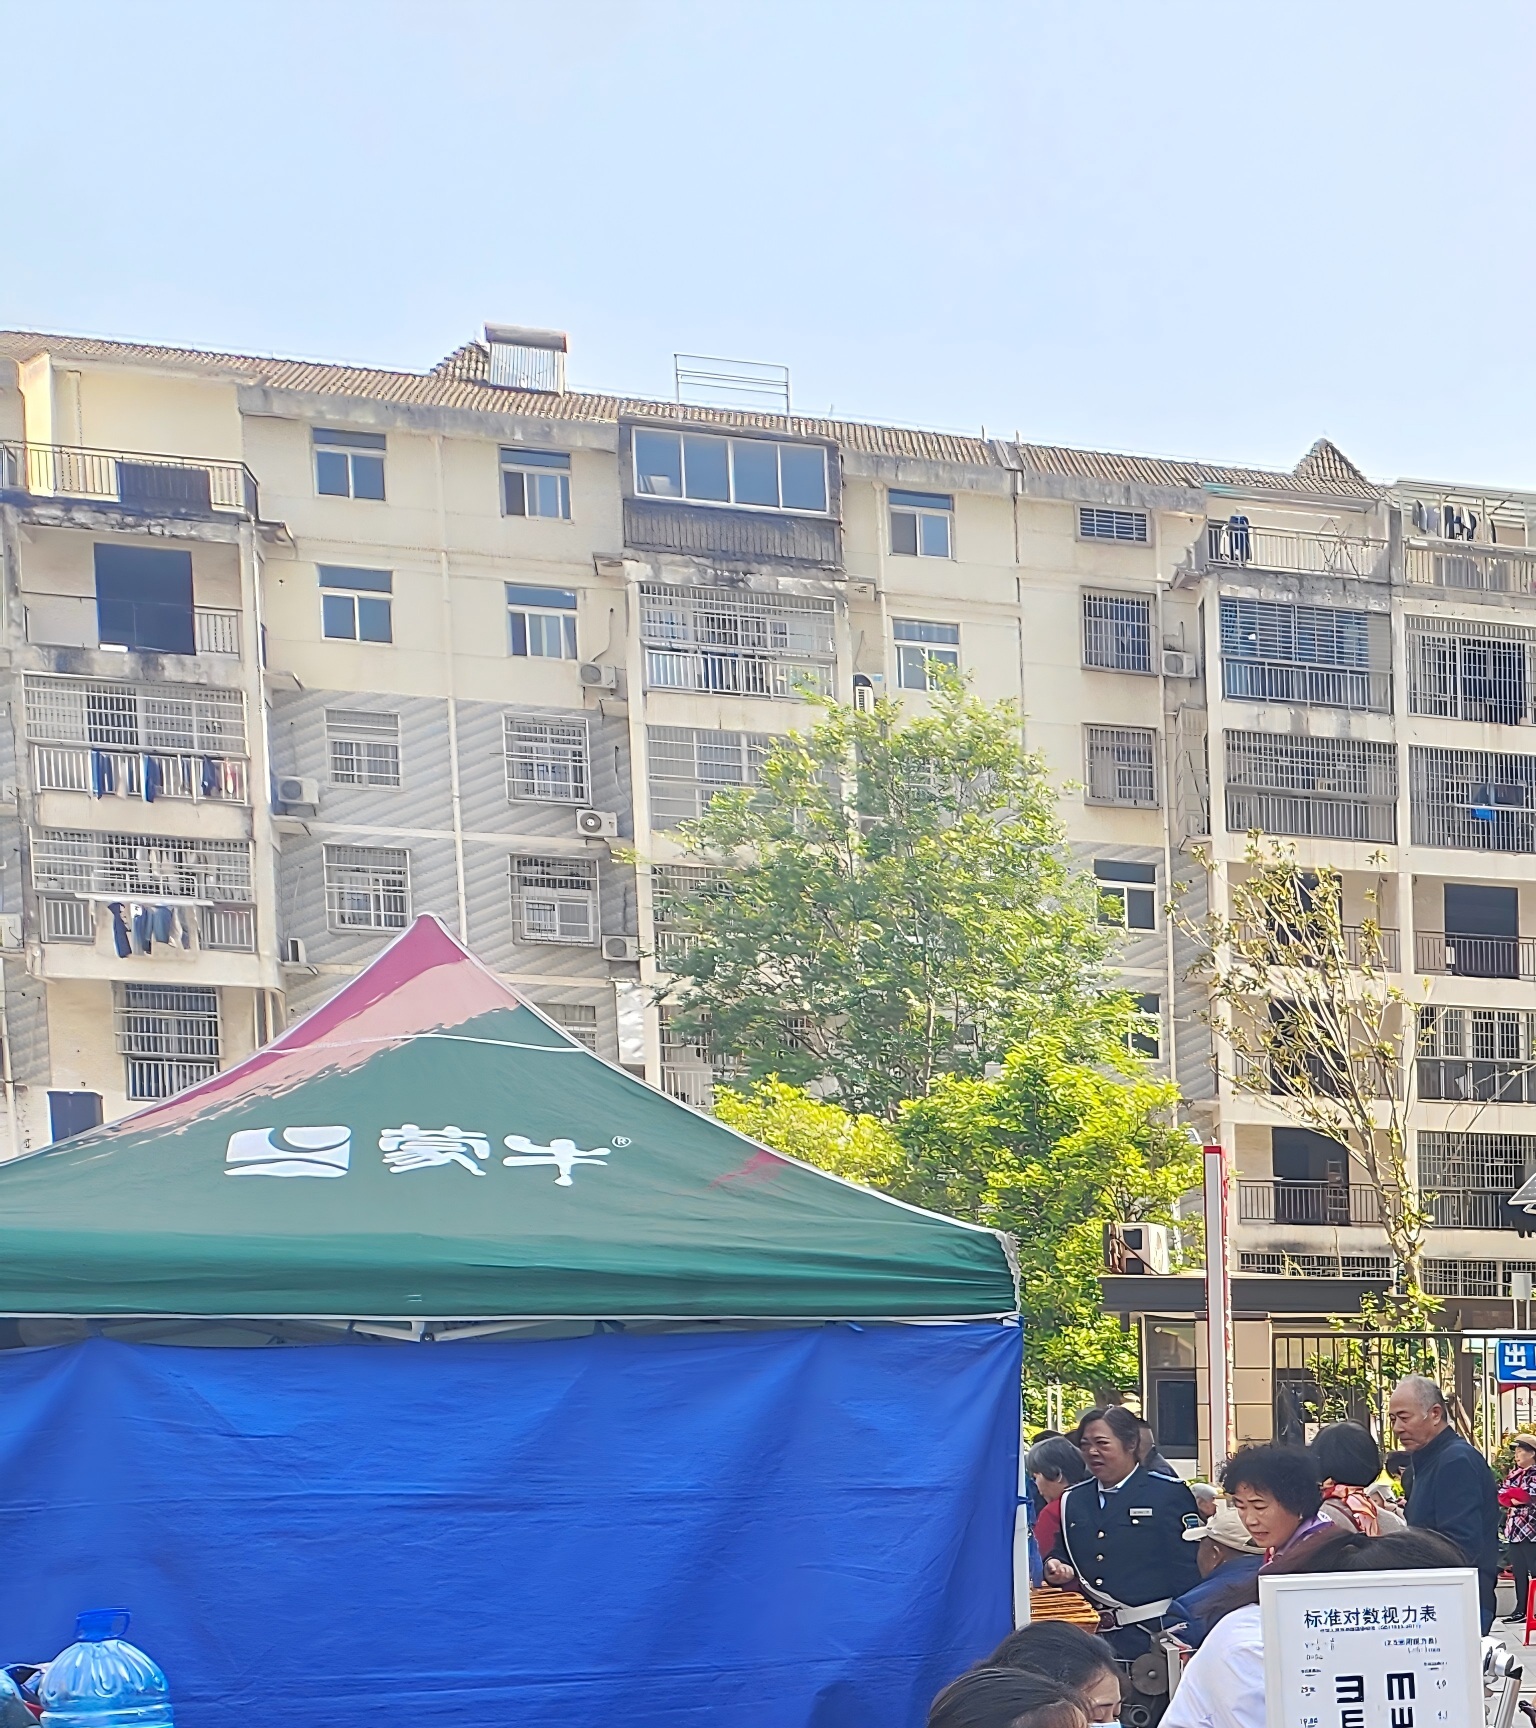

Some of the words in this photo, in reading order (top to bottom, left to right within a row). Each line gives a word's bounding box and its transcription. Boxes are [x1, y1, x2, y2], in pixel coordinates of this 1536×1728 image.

[378, 1123, 612, 1187] 蒙牛
[1304, 1604, 1437, 1629] 标准对数视力表
